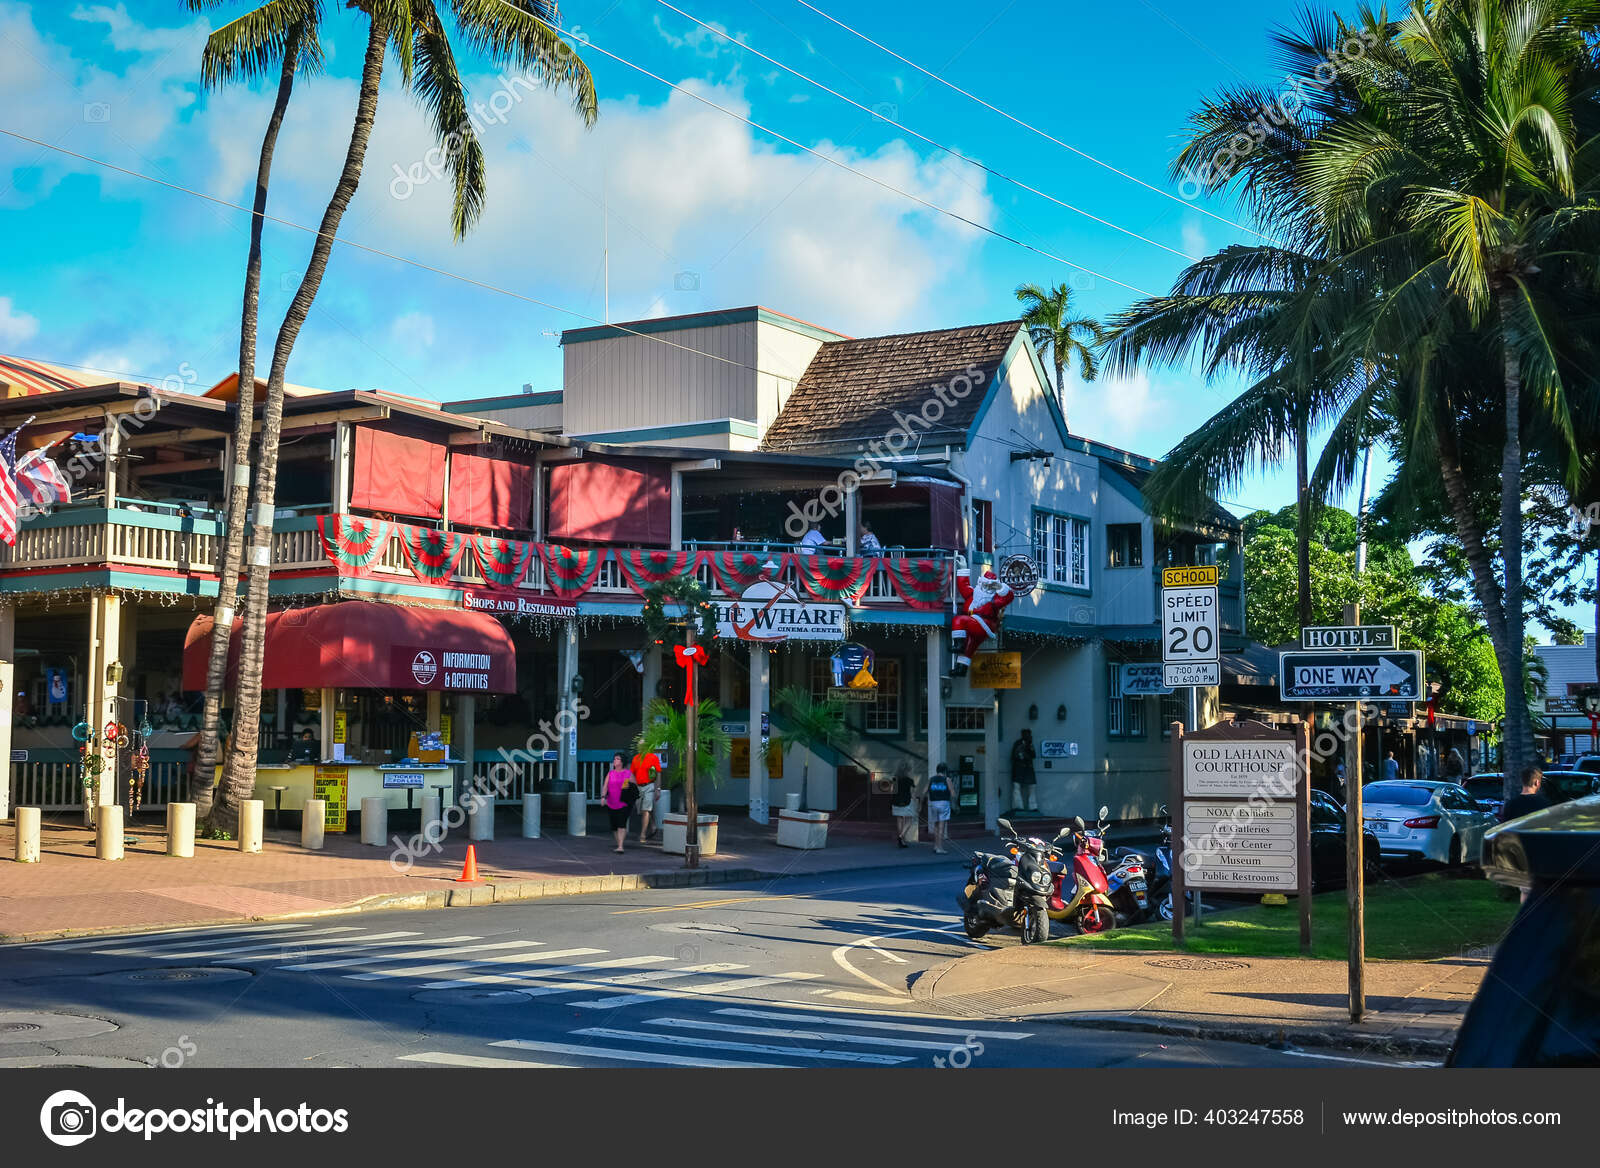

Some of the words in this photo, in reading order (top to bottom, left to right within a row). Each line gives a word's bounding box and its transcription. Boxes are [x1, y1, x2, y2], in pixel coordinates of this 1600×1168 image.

[1166, 570, 1214, 584] SCHOOL
[1167, 595, 1213, 609] SPEED
[750, 607, 843, 630] WHARF
[1172, 610, 1208, 623] LIMIT
[1168, 625, 1213, 654] 20
[1309, 630, 1374, 647] HOTEL
[1375, 632, 1388, 642] ST
[442, 652, 491, 671] INFORMATION
[1175, 666, 1192, 674] 7:00
[1195, 666, 1208, 674] AM
[1299, 668, 1336, 685] ONE
[1341, 667, 1379, 685] WAY
[444, 672, 450, 688] &
[451, 672, 488, 690] ACTIVITIES
[1169, 675, 1179, 684] TO
[1182, 675, 1200, 683] 6:00
[1204, 675, 1215, 683] PM
[1192, 749, 1221, 760] OLD
[1225, 749, 1286, 760] LAHAINA
[1194, 761, 1285, 773] COURTHOUSE
[1206, 807, 1236, 817] NOAA
[1239, 808, 1274, 818] Exhibits
[1211, 824, 1227, 833] Art
[1230, 824, 1270, 834] Galleries
[1209, 839, 1239, 849] Visitor
[1241, 839, 1273, 849] Center
[1219, 855, 1262, 865] Museum
[1201, 871, 1230, 881] Public
[1232, 872, 1280, 882] Restrooms
